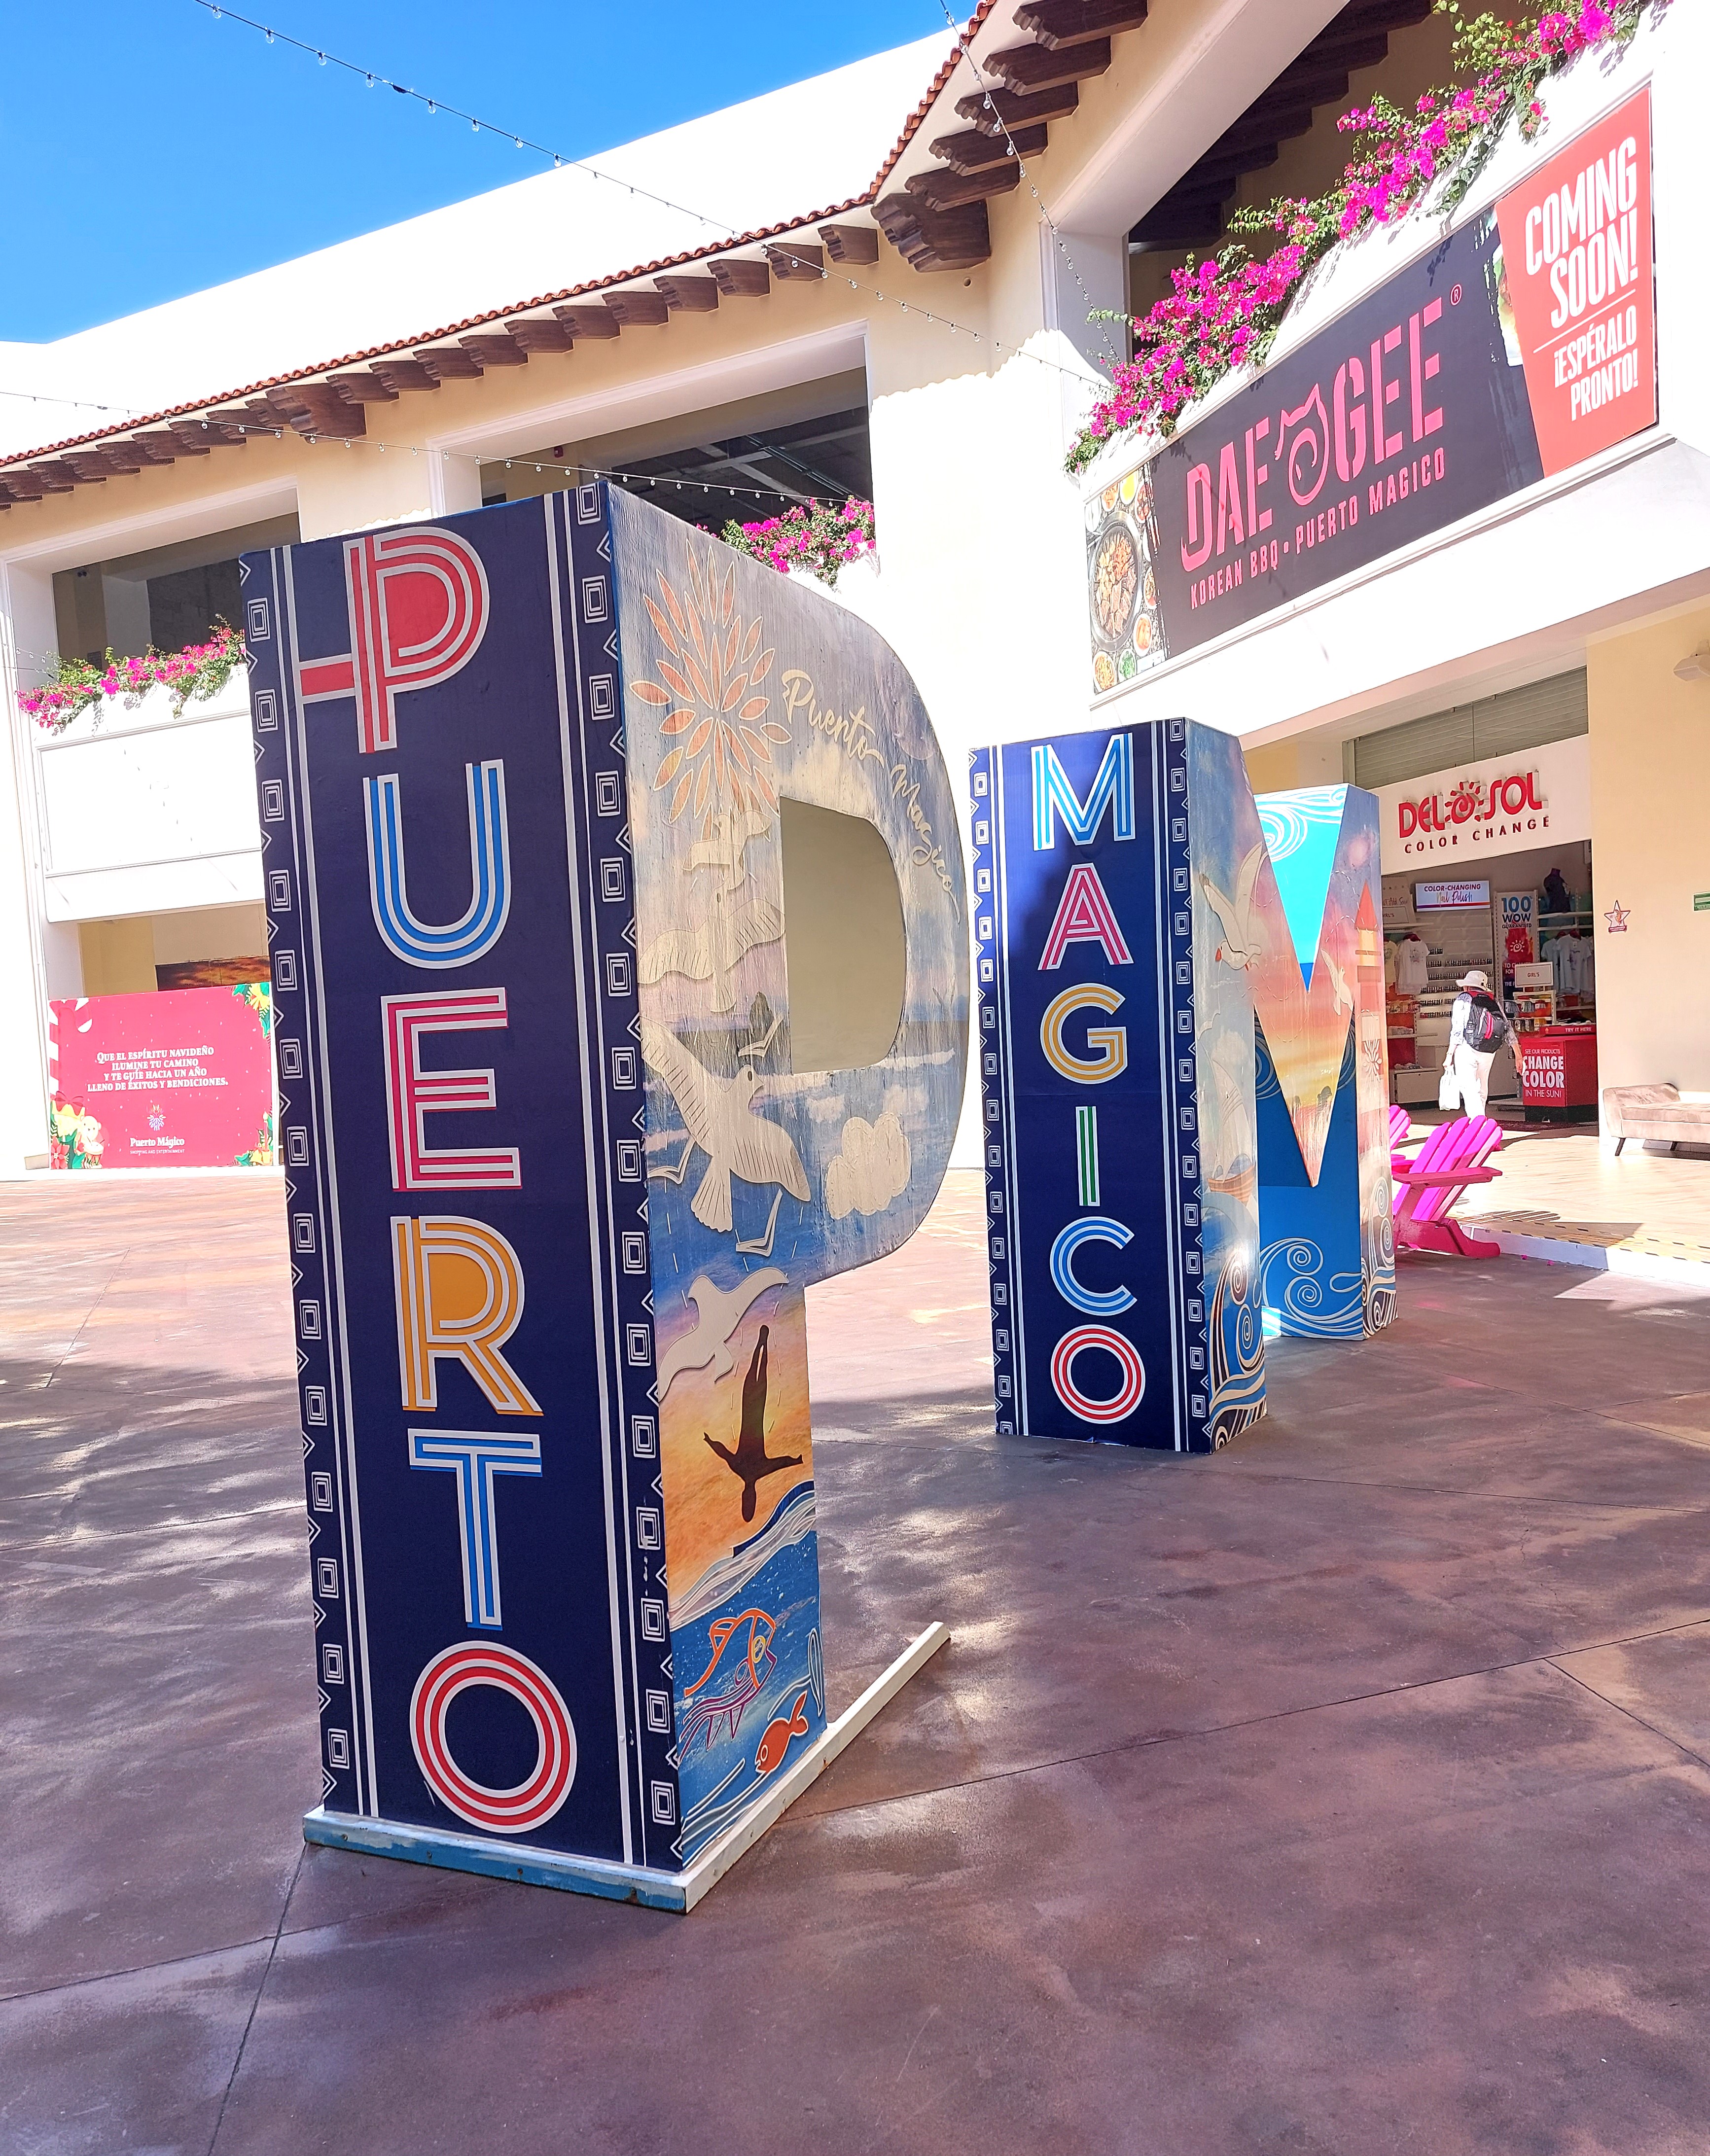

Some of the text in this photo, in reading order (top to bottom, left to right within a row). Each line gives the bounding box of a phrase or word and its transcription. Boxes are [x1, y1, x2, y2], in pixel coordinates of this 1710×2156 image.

[1524, 136, 1638, 277] COMING
[1549, 210, 1639, 329] SOON!
[1554, 304, 1638, 389] ¡ESPÉRALO
[1570, 350, 1639, 422] PRONTO!
[1191, 447, 1446, 610] KOREAN BBQ PUERTO MAGICO
[781, 669, 962, 924] Puerto Magico
[1398, 772, 1543, 838] DEL SOL
[1404, 816, 1549, 853] COLOR CHANGE
[1424, 884, 1481, 892] COLOR-CHANGING
[1436, 890, 1473, 904] Nail Polish
[1502, 913, 1531, 923] WOW
[97, 1045, 214, 1065] QUE EL ESPÍRITU NAVIDEÑO
[111, 1059, 199, 1071] ILUMINE TU CAMINO
[1523, 1056, 1564, 1070] CHANGE
[87, 1083, 113, 1093] LLENO
[115, 1083, 127, 1091] DE
[128, 1080, 158, 1091] ÉXITOS
[166, 1078, 229, 1089] BENDICIONES.
[123, 1069, 144, 1080] GUÍE
[145, 1071, 173, 1079] HACIA
[174, 1070, 187, 1078] UN
[188, 1065, 207, 1077] AÑO
[1031, 732, 1146, 1424] MAGICO
[1522, 1070, 1565, 1088] COLOR
[130, 1136, 185, 1149] Puerto Mágico
[344, 526, 577, 1834] PUERTO
